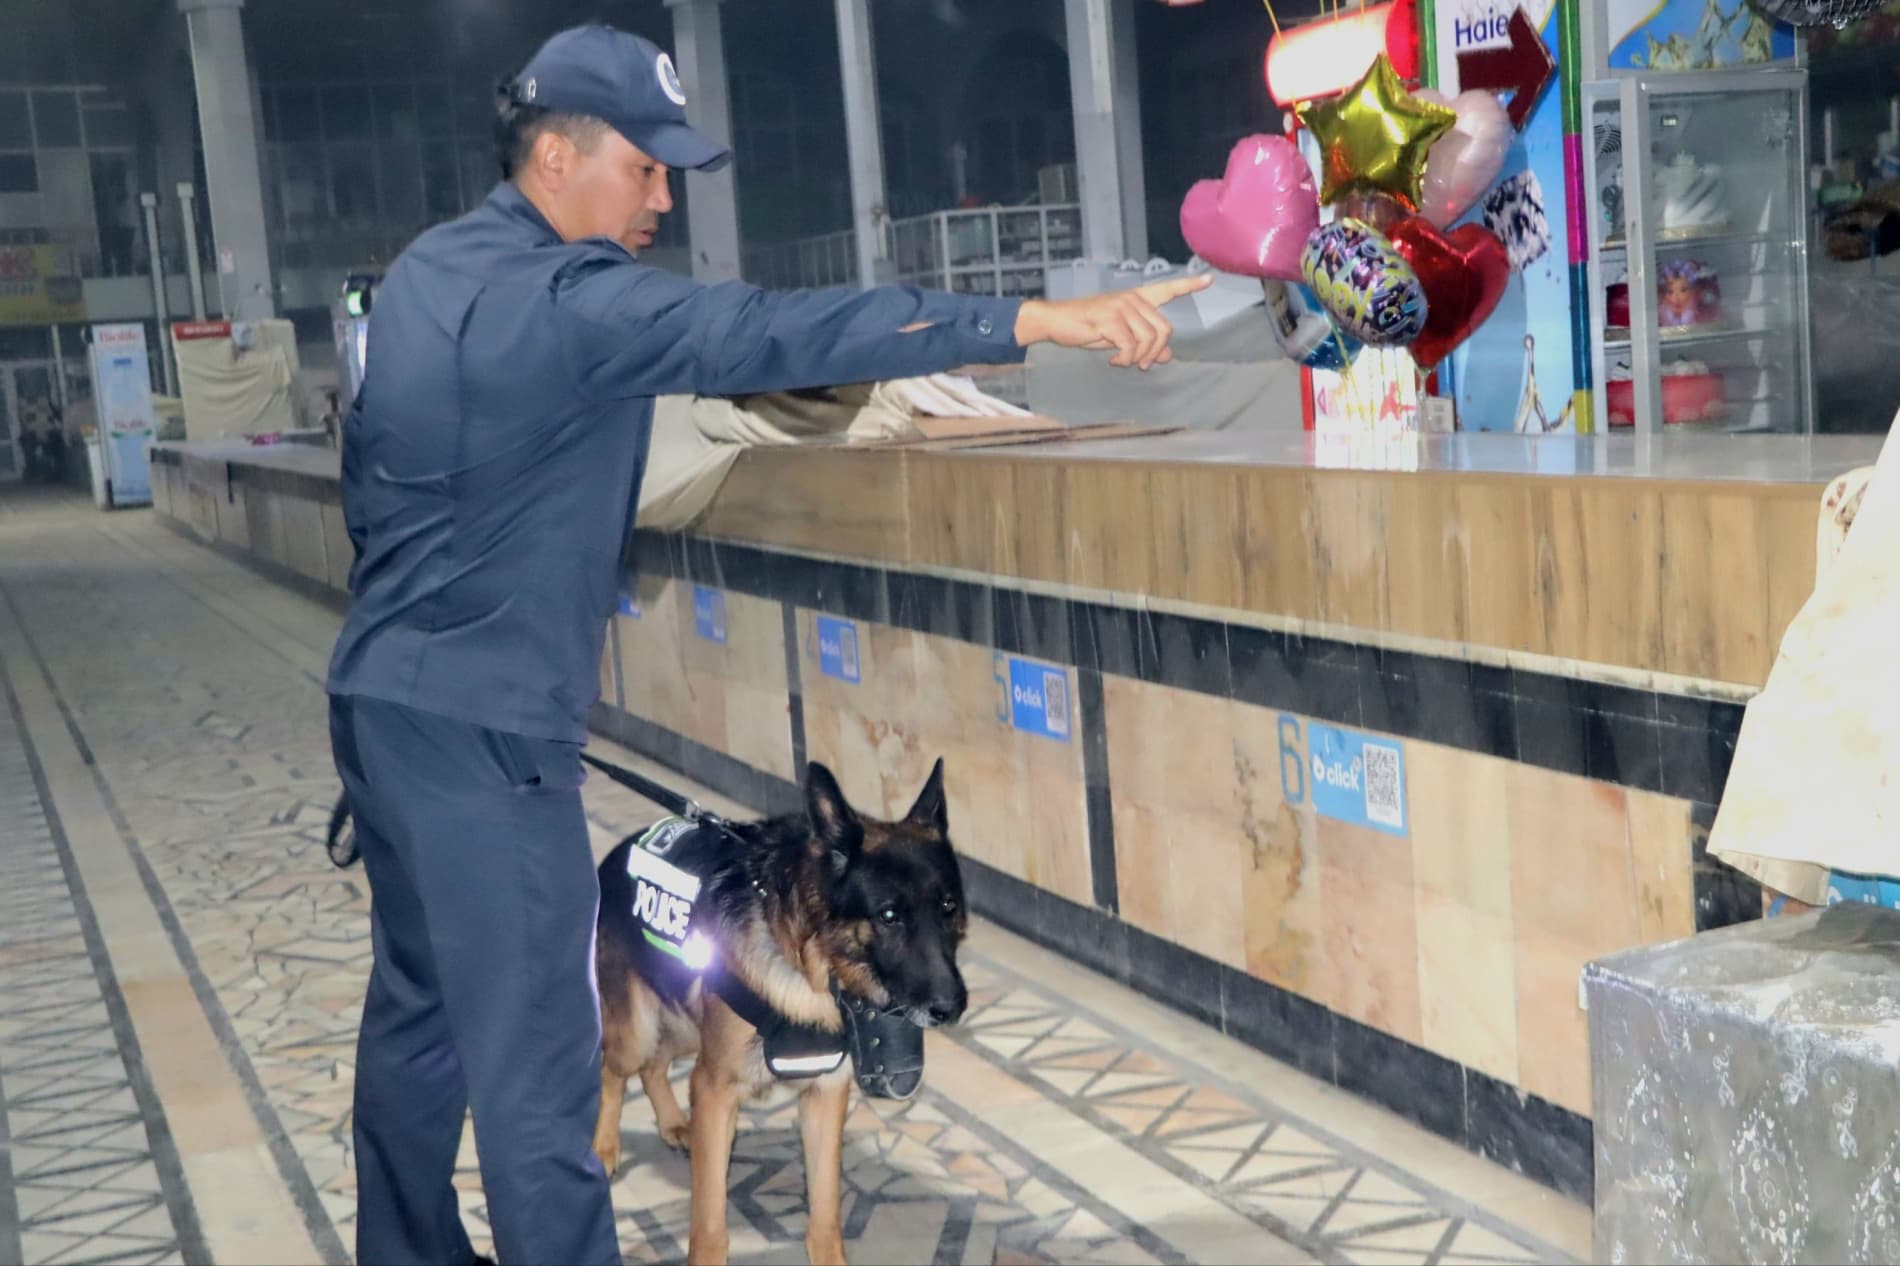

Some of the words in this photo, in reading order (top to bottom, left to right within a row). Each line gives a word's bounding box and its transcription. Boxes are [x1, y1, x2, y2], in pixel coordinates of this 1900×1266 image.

[1455, 7, 1509, 48] Haie
[1278, 712, 1305, 805] 6
[1326, 762, 1360, 792] click
[632, 879, 691, 940] POLICE
